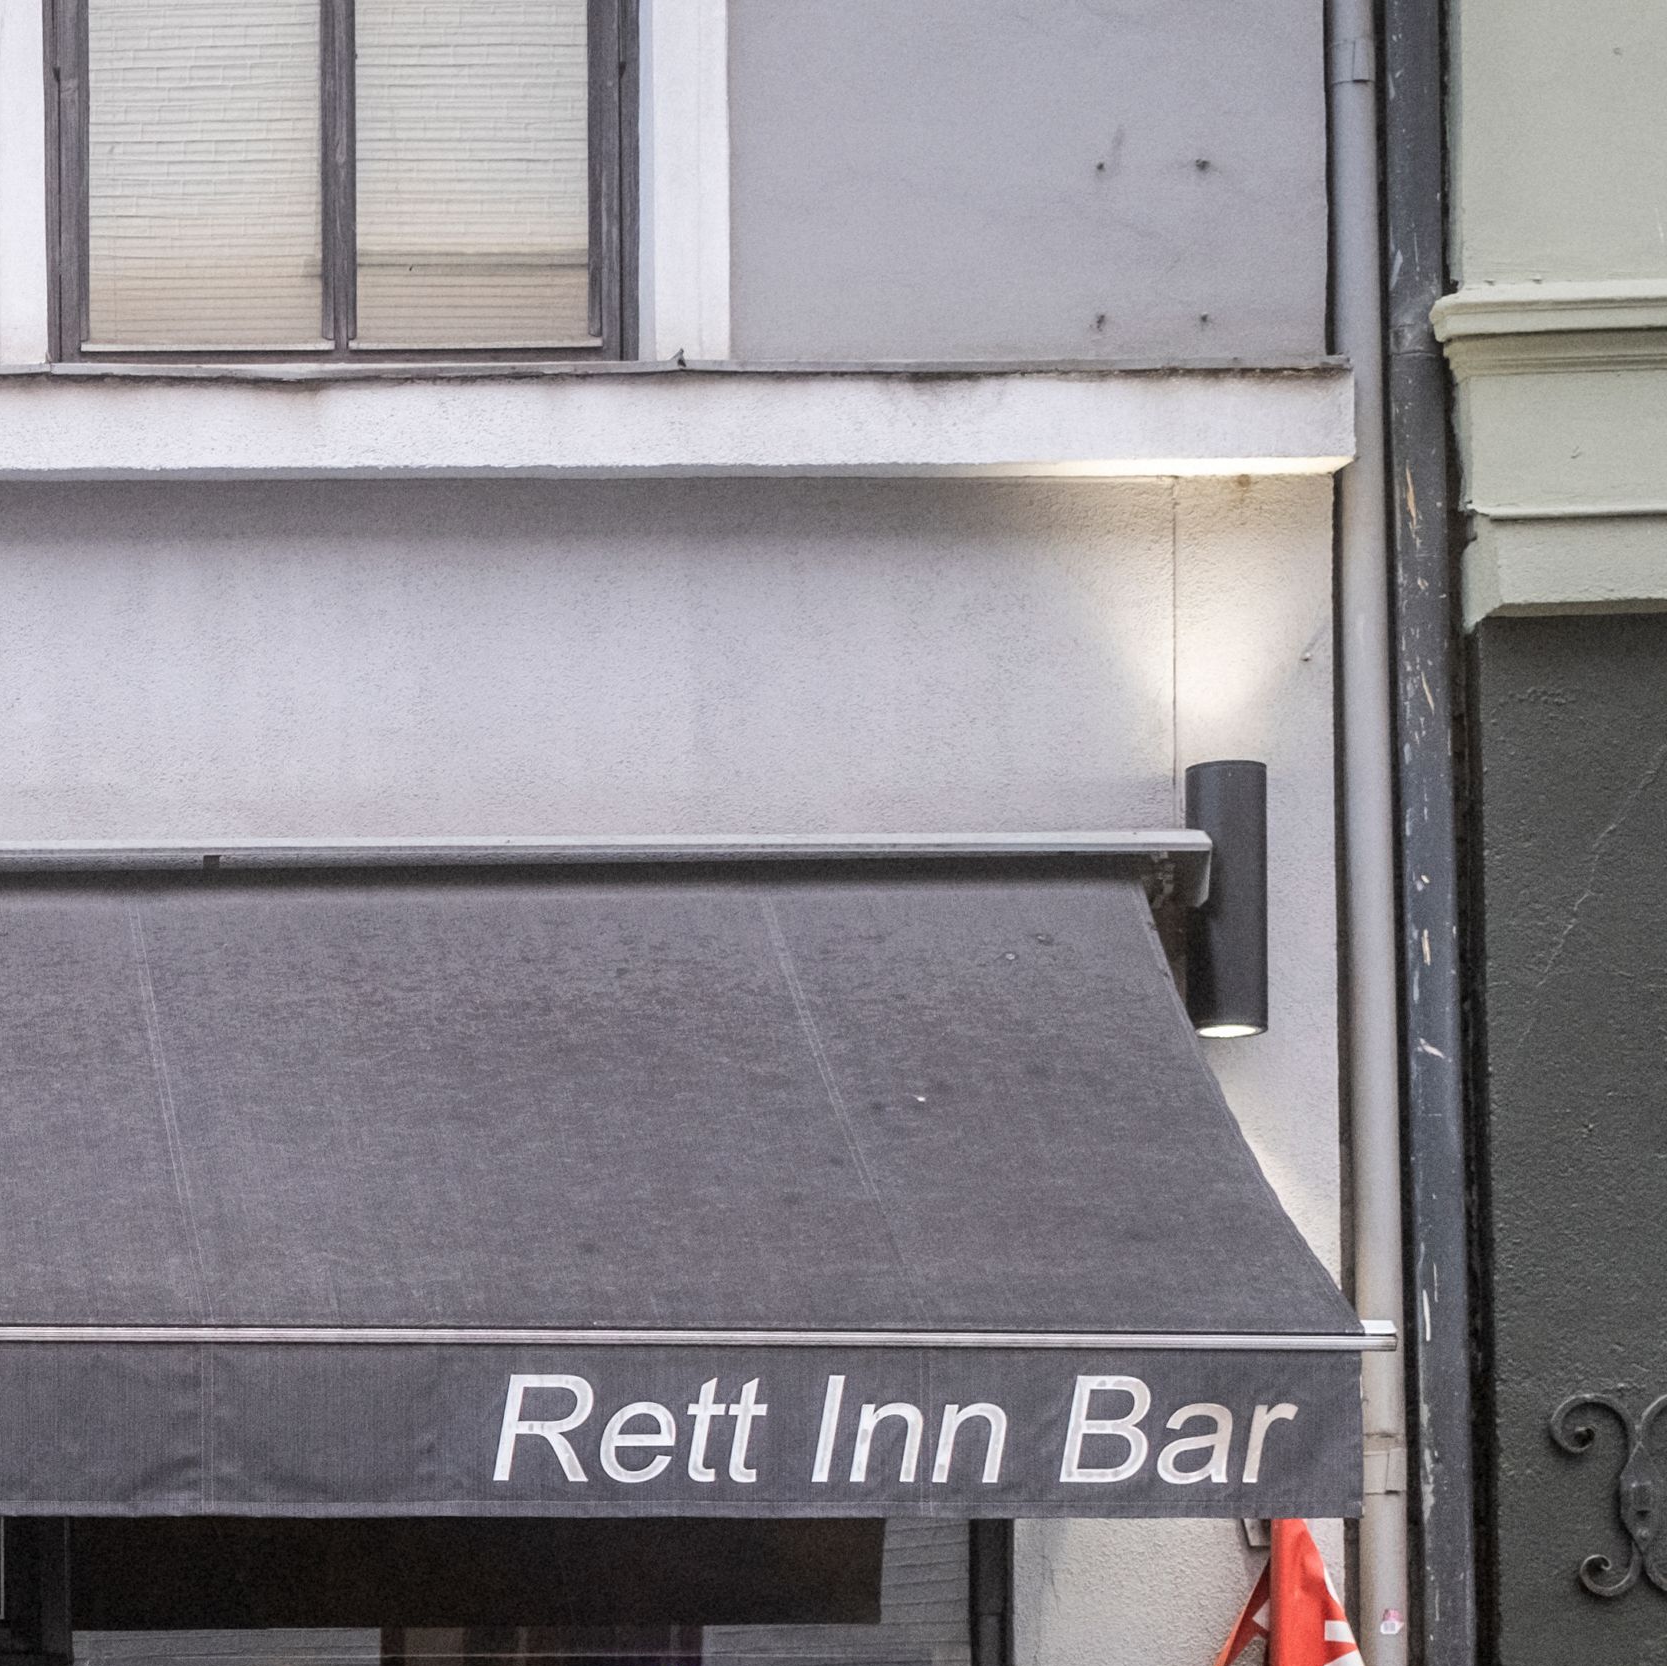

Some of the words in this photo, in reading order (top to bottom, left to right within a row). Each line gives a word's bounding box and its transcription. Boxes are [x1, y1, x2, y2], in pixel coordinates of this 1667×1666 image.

[493, 1374, 768, 1483] Rett
[812, 1375, 1007, 1483] Inn
[1060, 1375, 1298, 1484] Bar
